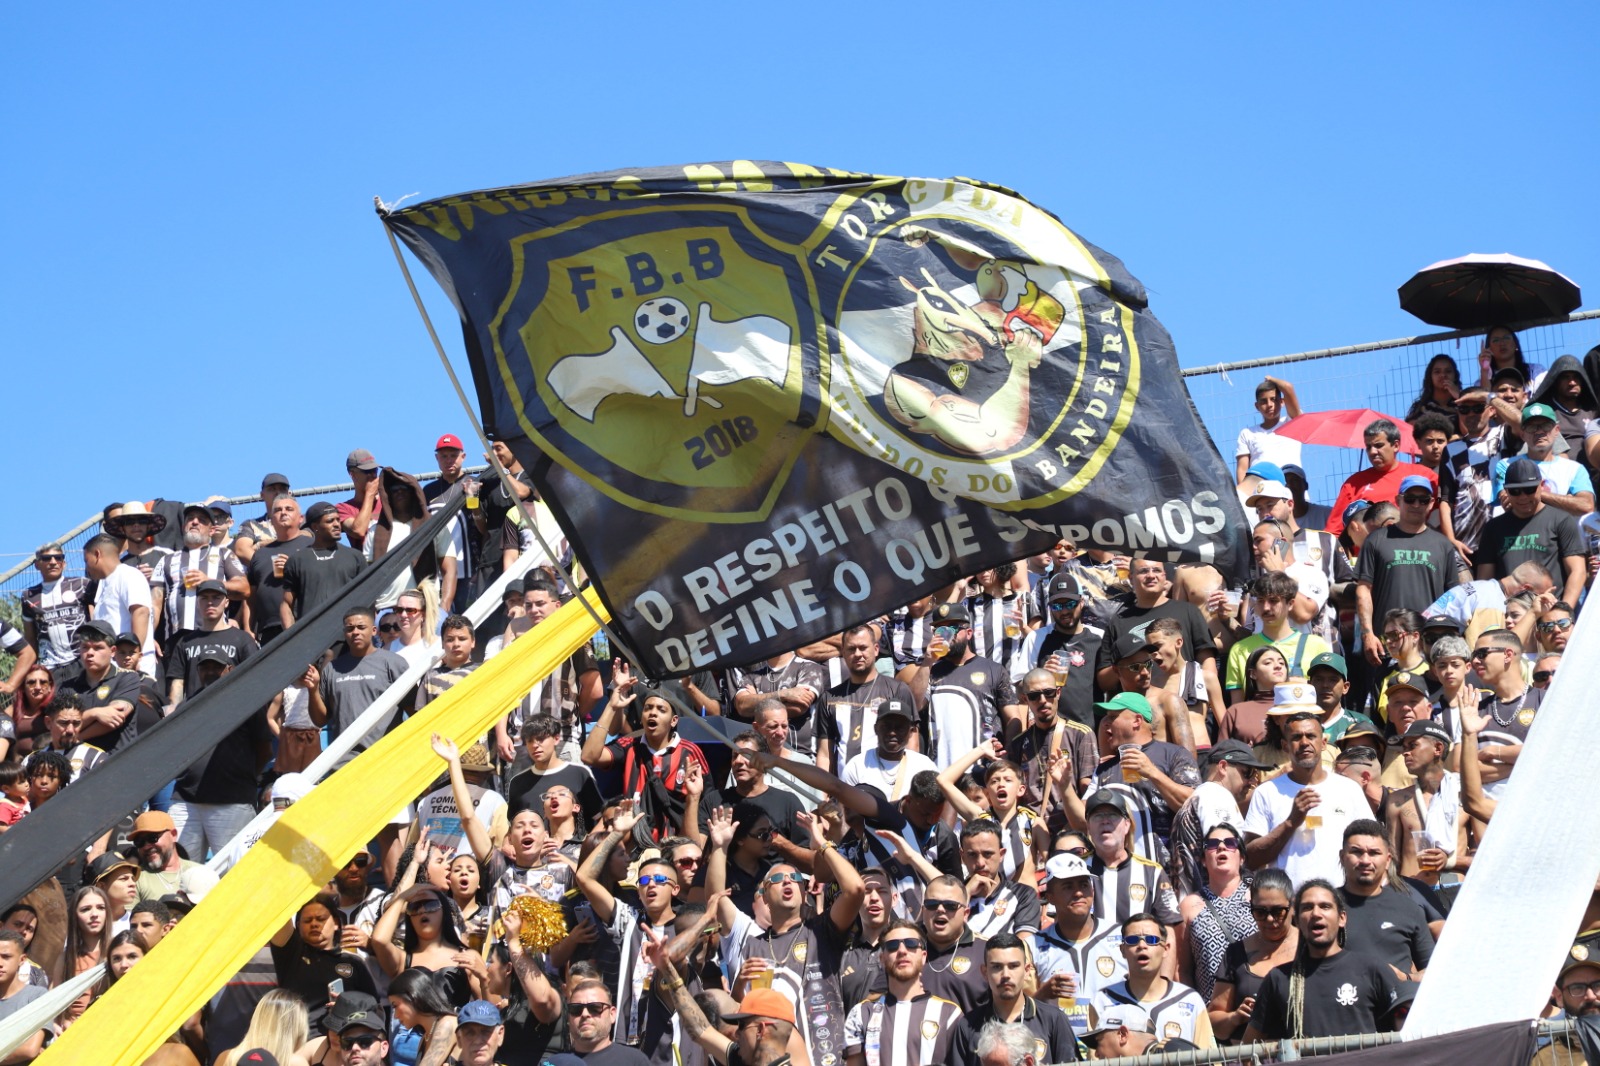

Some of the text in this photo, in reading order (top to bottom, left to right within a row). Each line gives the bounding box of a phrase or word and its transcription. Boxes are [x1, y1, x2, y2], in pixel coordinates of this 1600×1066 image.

[815, 179, 1024, 272] TORCIDA
[683, 415, 759, 471] 2018
[967, 473, 1012, 493] DO
[1035, 306, 1123, 480] BANDEIRA
[634, 590, 673, 631] O
[682, 477, 912, 613] RESPEITO
[654, 578, 827, 672] DEFINE
[833, 560, 871, 602] O
[885, 513, 980, 586] QUE
[1394, 549, 1431, 561] FUT
